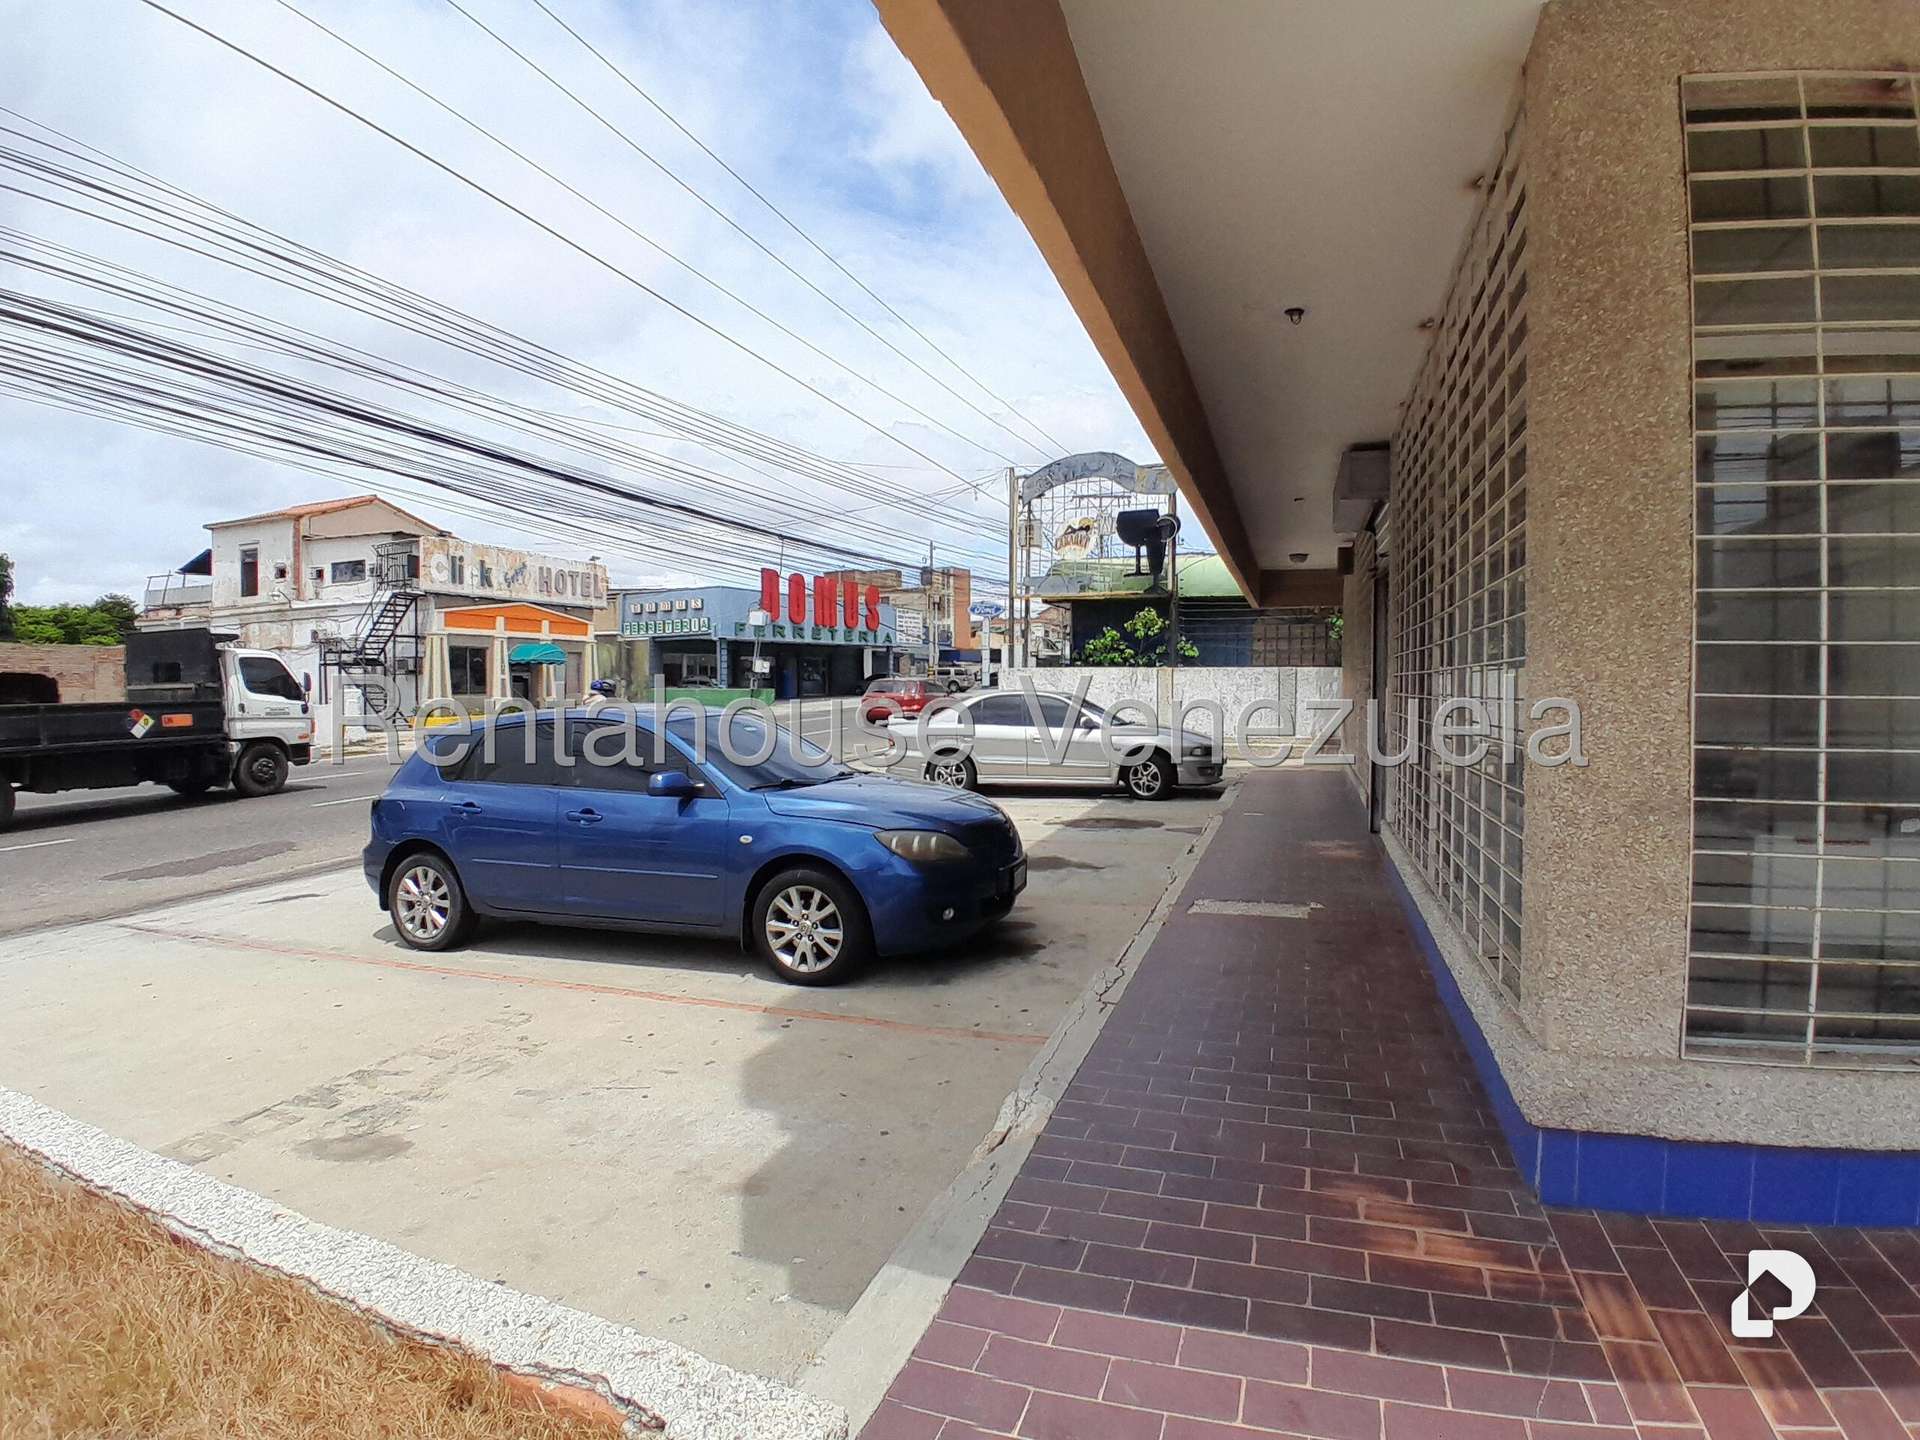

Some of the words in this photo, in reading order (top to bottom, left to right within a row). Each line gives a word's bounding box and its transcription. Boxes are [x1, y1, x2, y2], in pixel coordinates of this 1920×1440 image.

[538, 566, 604, 599] HOTEL
[631, 598, 703, 614] DOMUS
[760, 568, 880, 631] DOMUS
[623, 617, 709, 635] FERRETERIA
[735, 622, 892, 643] FERRETERIA
